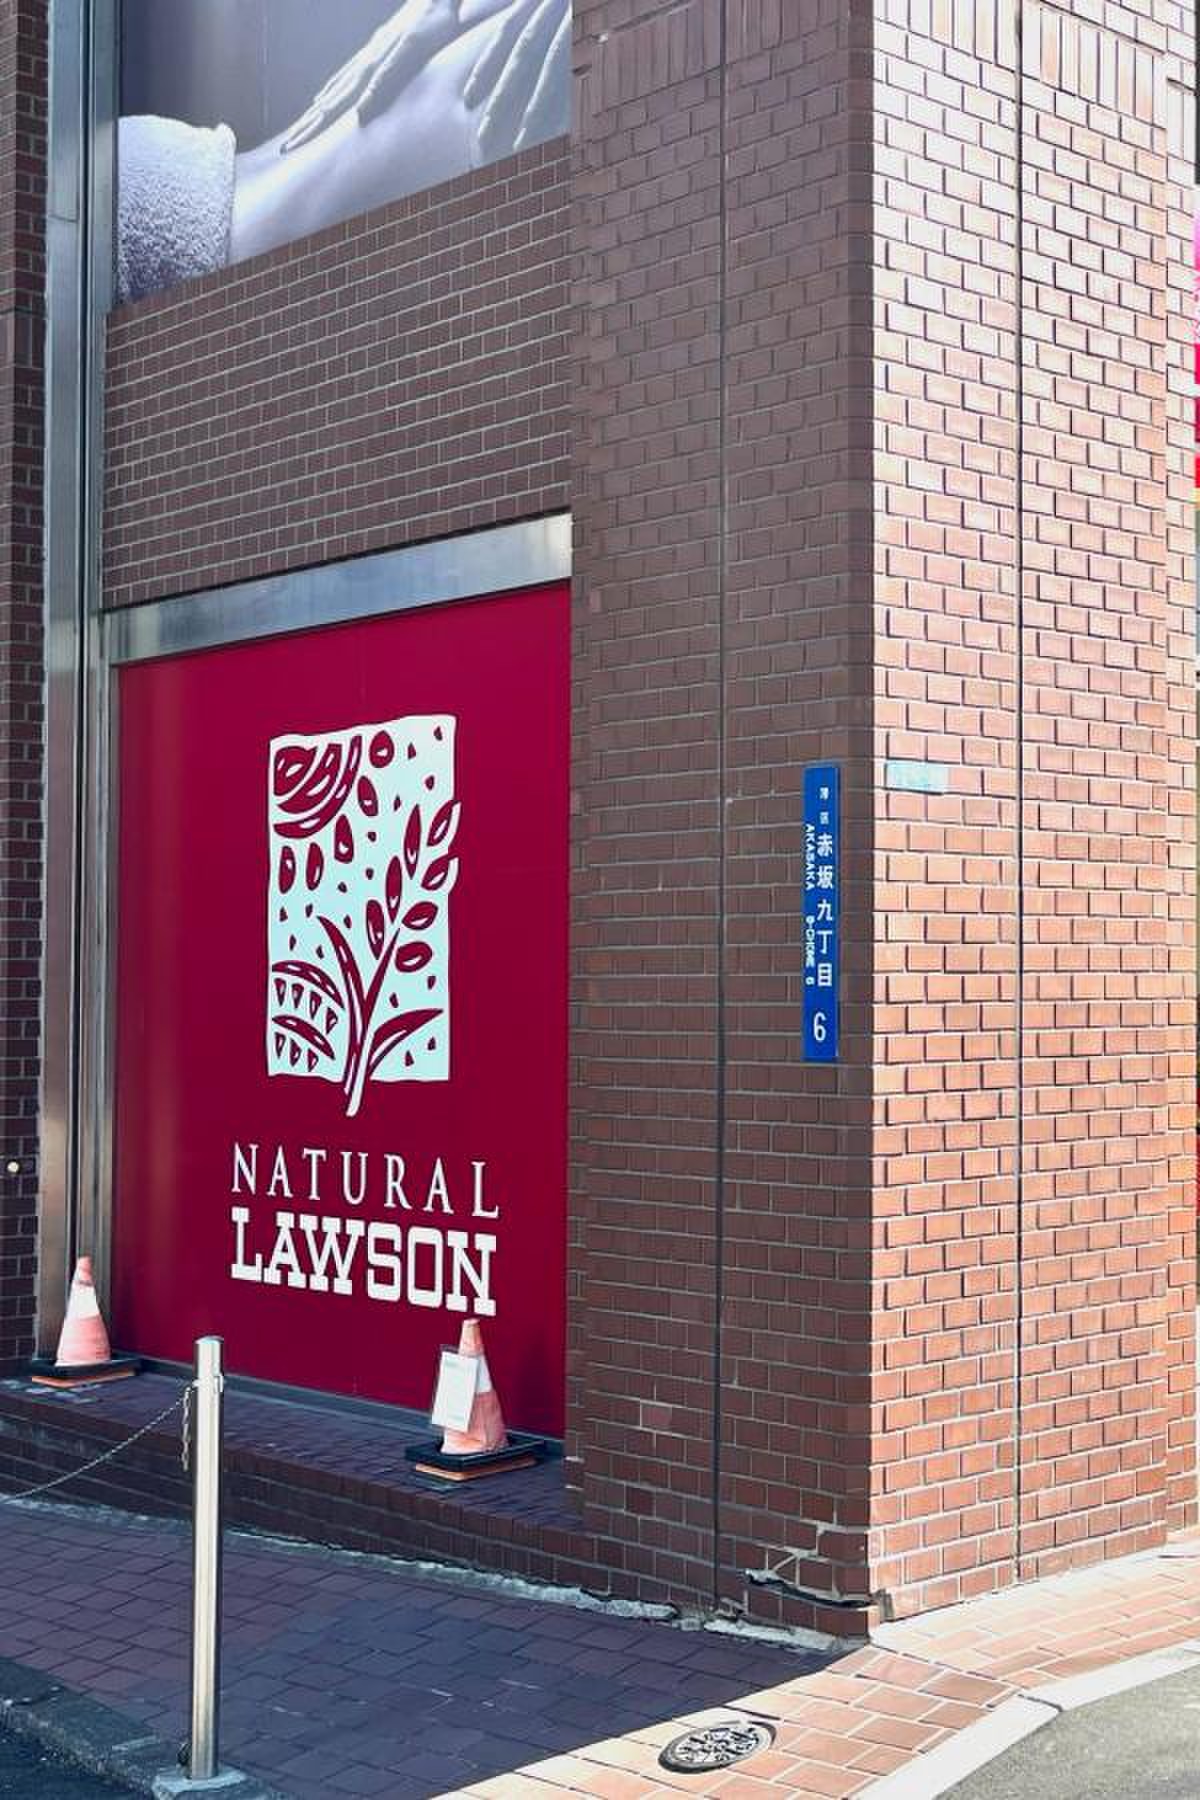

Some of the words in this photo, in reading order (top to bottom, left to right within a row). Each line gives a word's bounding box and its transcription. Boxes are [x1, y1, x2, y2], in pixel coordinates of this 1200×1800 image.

[805, 824, 815, 890] AKASAKA
[813, 1011, 827, 1042] 6
[231, 1142, 499, 1218] NATURAL
[231, 1206, 497, 1316] LAWSON
